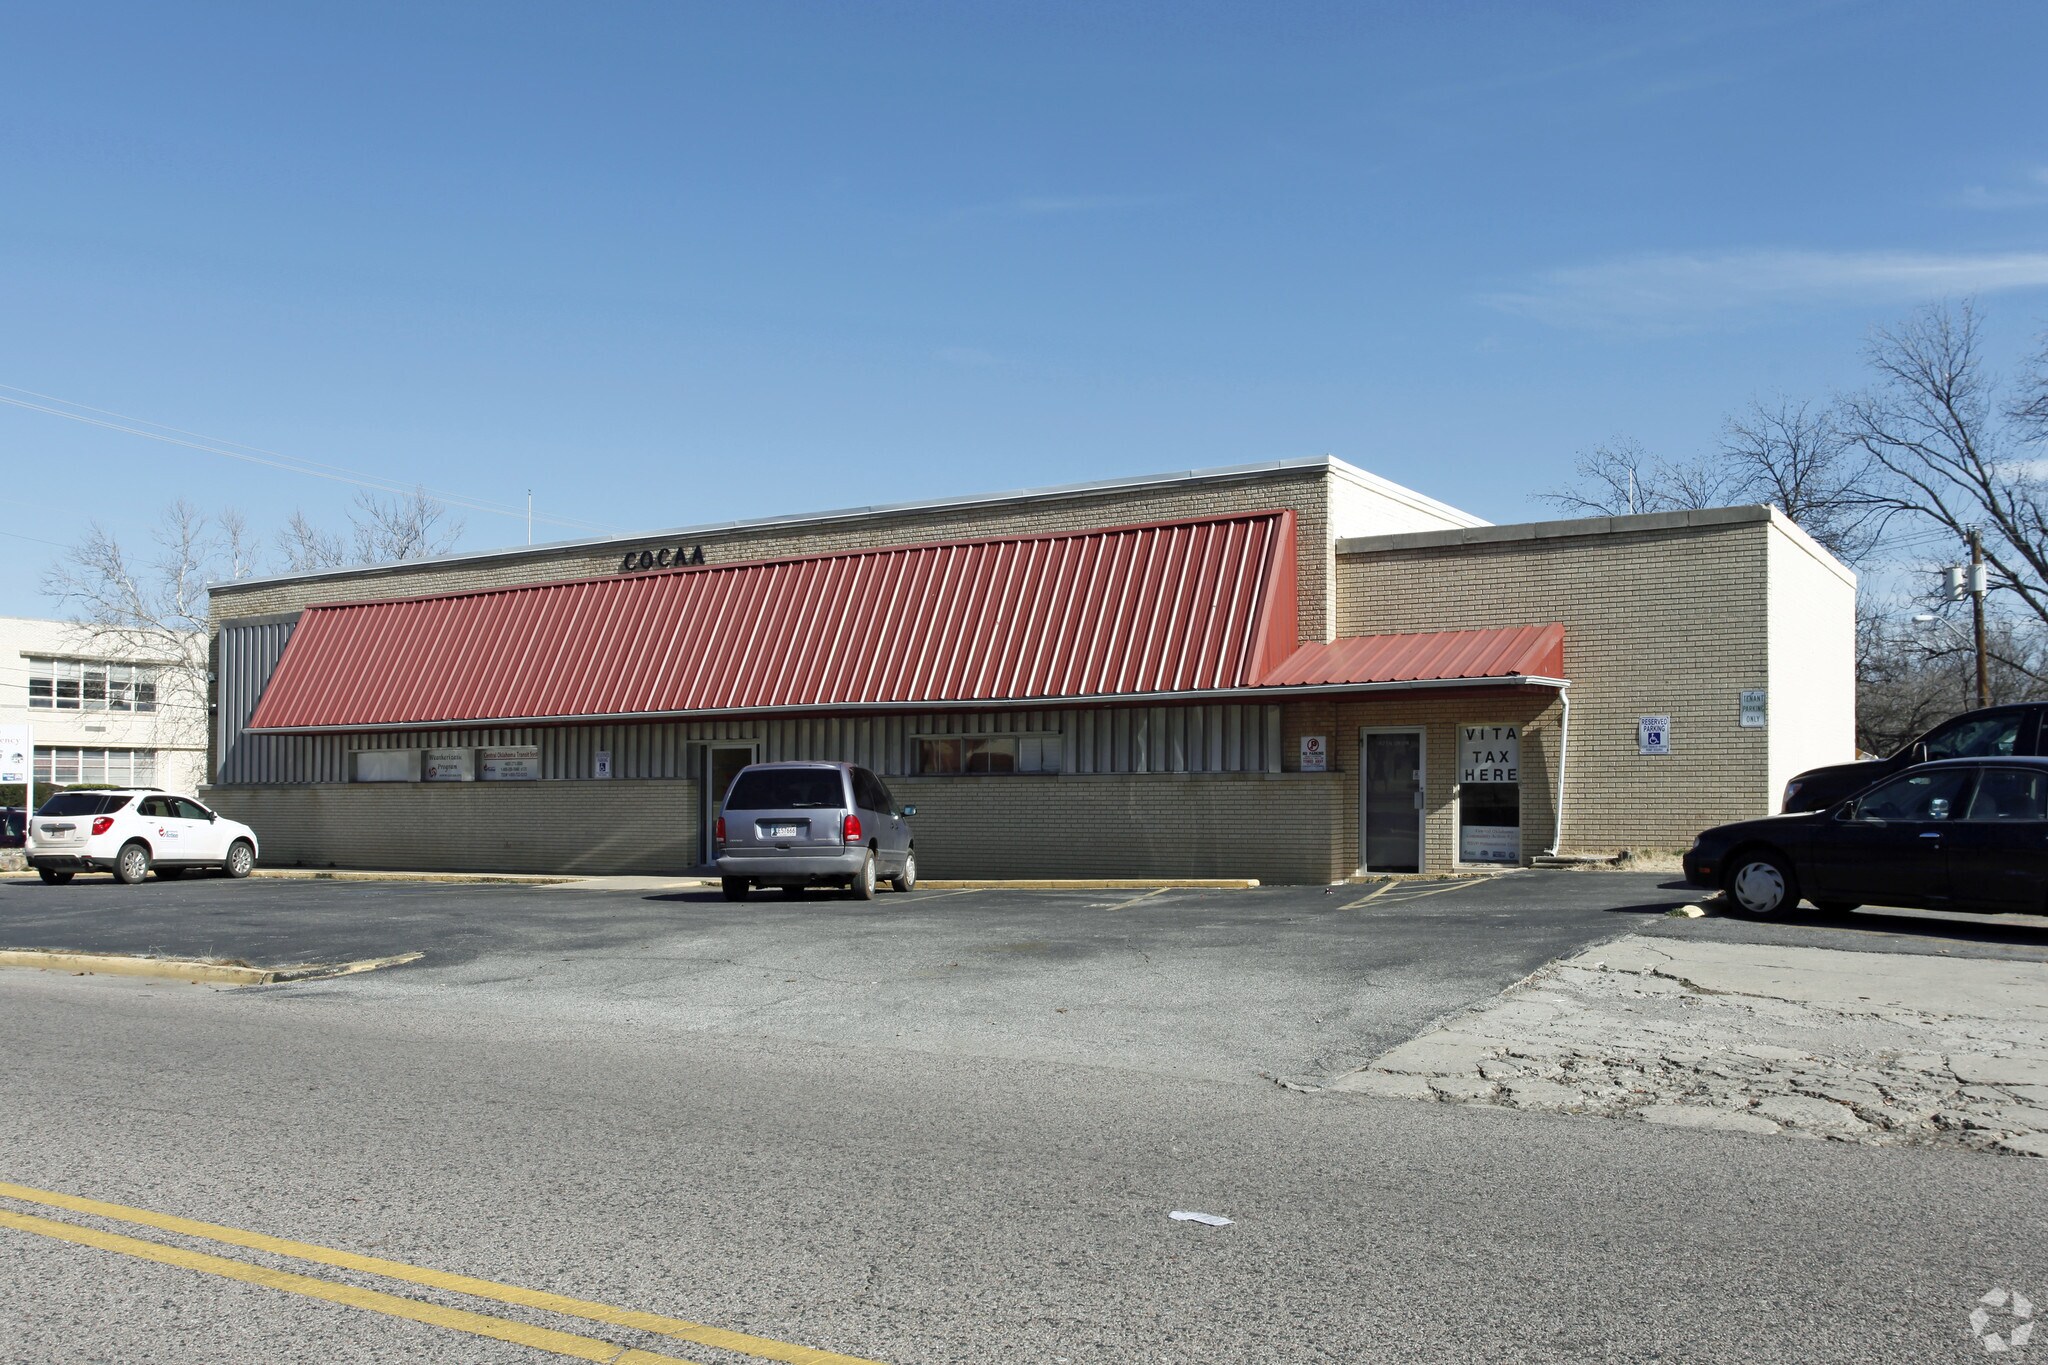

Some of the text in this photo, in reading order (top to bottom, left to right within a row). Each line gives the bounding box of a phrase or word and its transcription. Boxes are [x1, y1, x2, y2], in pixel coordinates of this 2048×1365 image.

[624, 545, 705, 570] COCAA
[1641, 718, 1667, 726] RESERVED
[1465, 727, 1517, 740] VITA
[1472, 750, 1509, 763] TAX
[437, 763, 458, 773] Program
[1465, 768, 1517, 781] HERE
